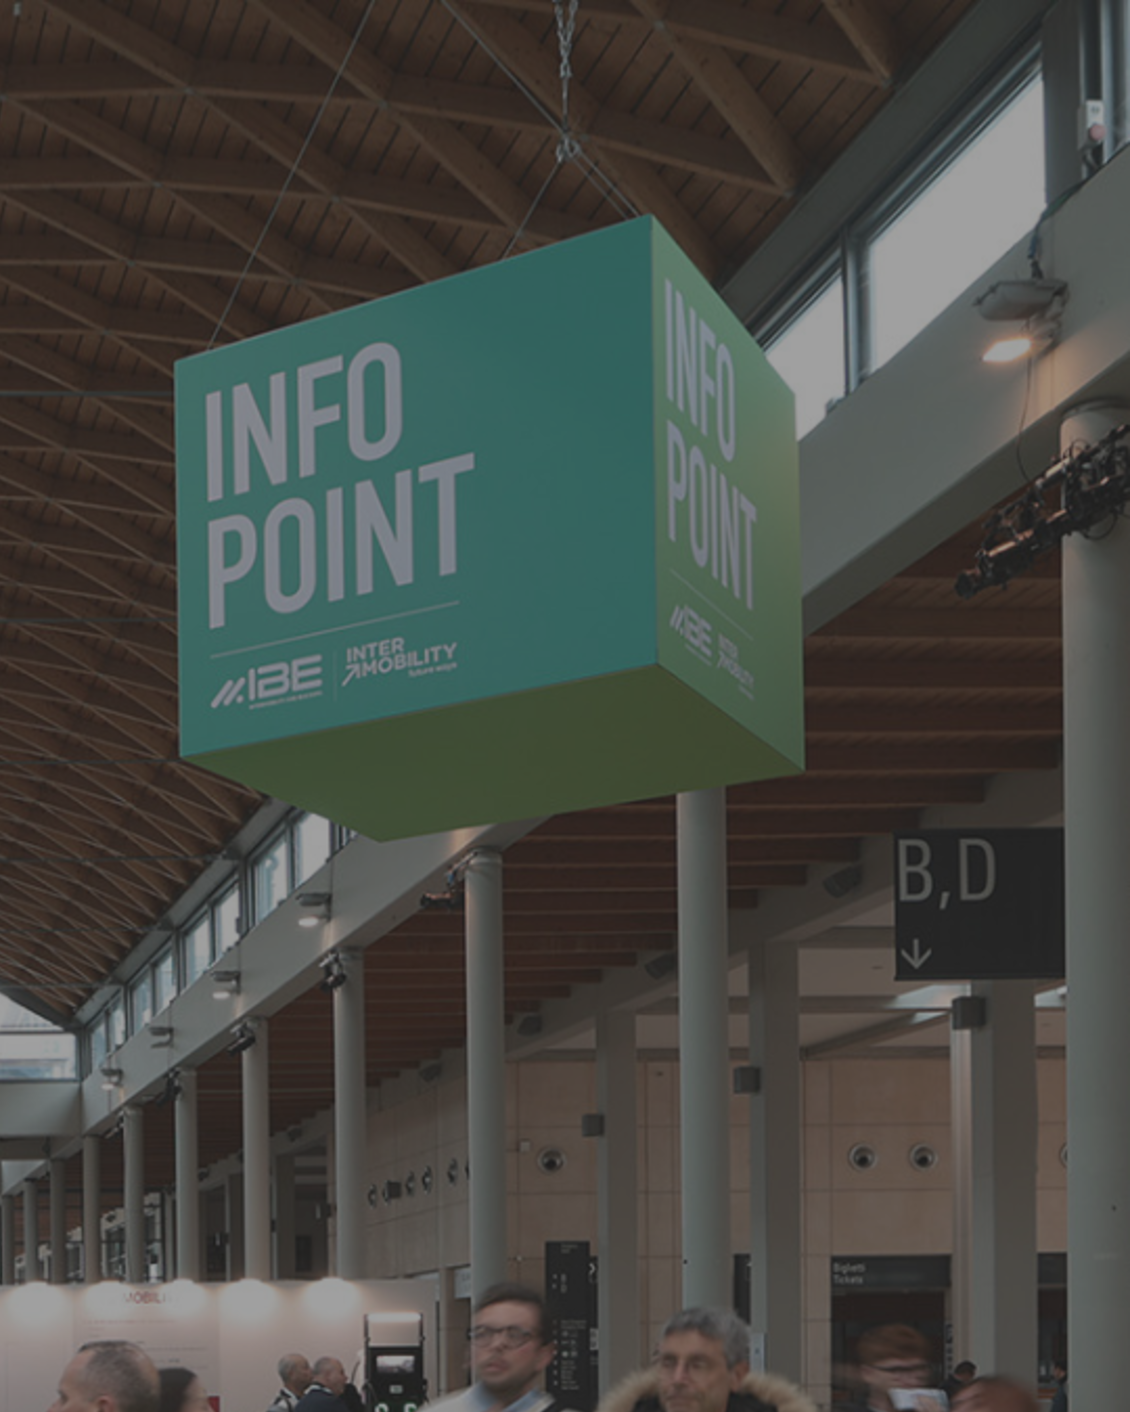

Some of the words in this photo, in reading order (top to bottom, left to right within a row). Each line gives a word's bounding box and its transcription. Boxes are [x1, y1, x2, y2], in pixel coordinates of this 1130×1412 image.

[205, 342, 403, 502] INFO
[665, 278, 735, 462] INFO
[207, 452, 475, 629] POINT
[667, 420, 757, 610] POINT
[347, 637, 405, 663] INTER
[361, 643, 457, 678] MOBILITY
[899, 838, 996, 909] B,D
